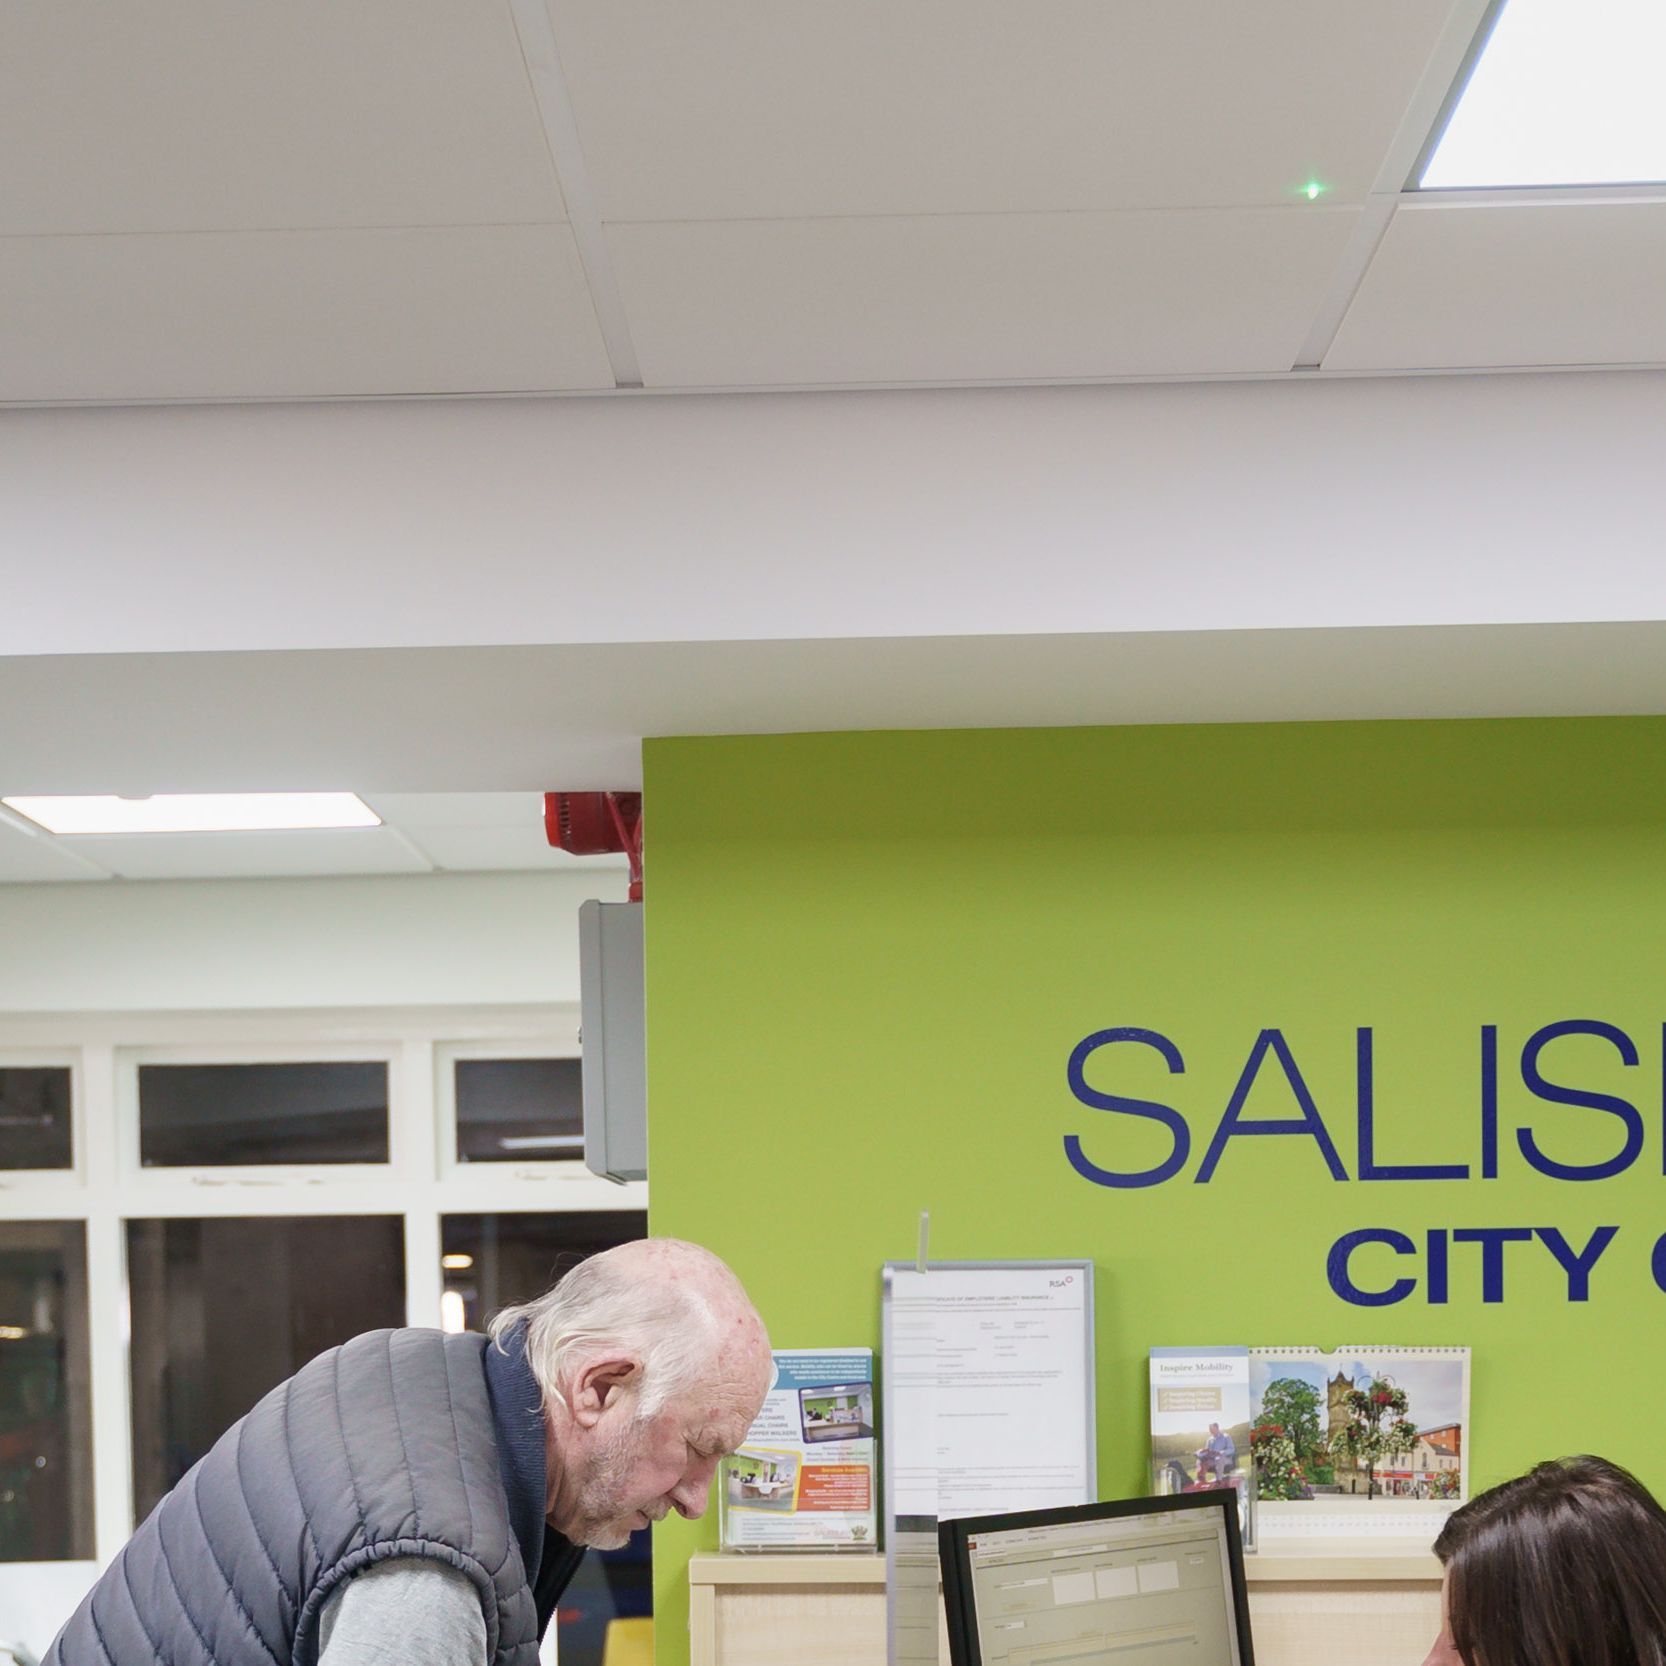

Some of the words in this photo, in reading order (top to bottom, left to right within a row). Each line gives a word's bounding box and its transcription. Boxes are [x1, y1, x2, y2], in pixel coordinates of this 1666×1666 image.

[1326, 1227, 1617, 1306] CITY
[1160, 1364, 1192, 1373] Inspire
[1195, 1362, 1234, 1372] Mobility
